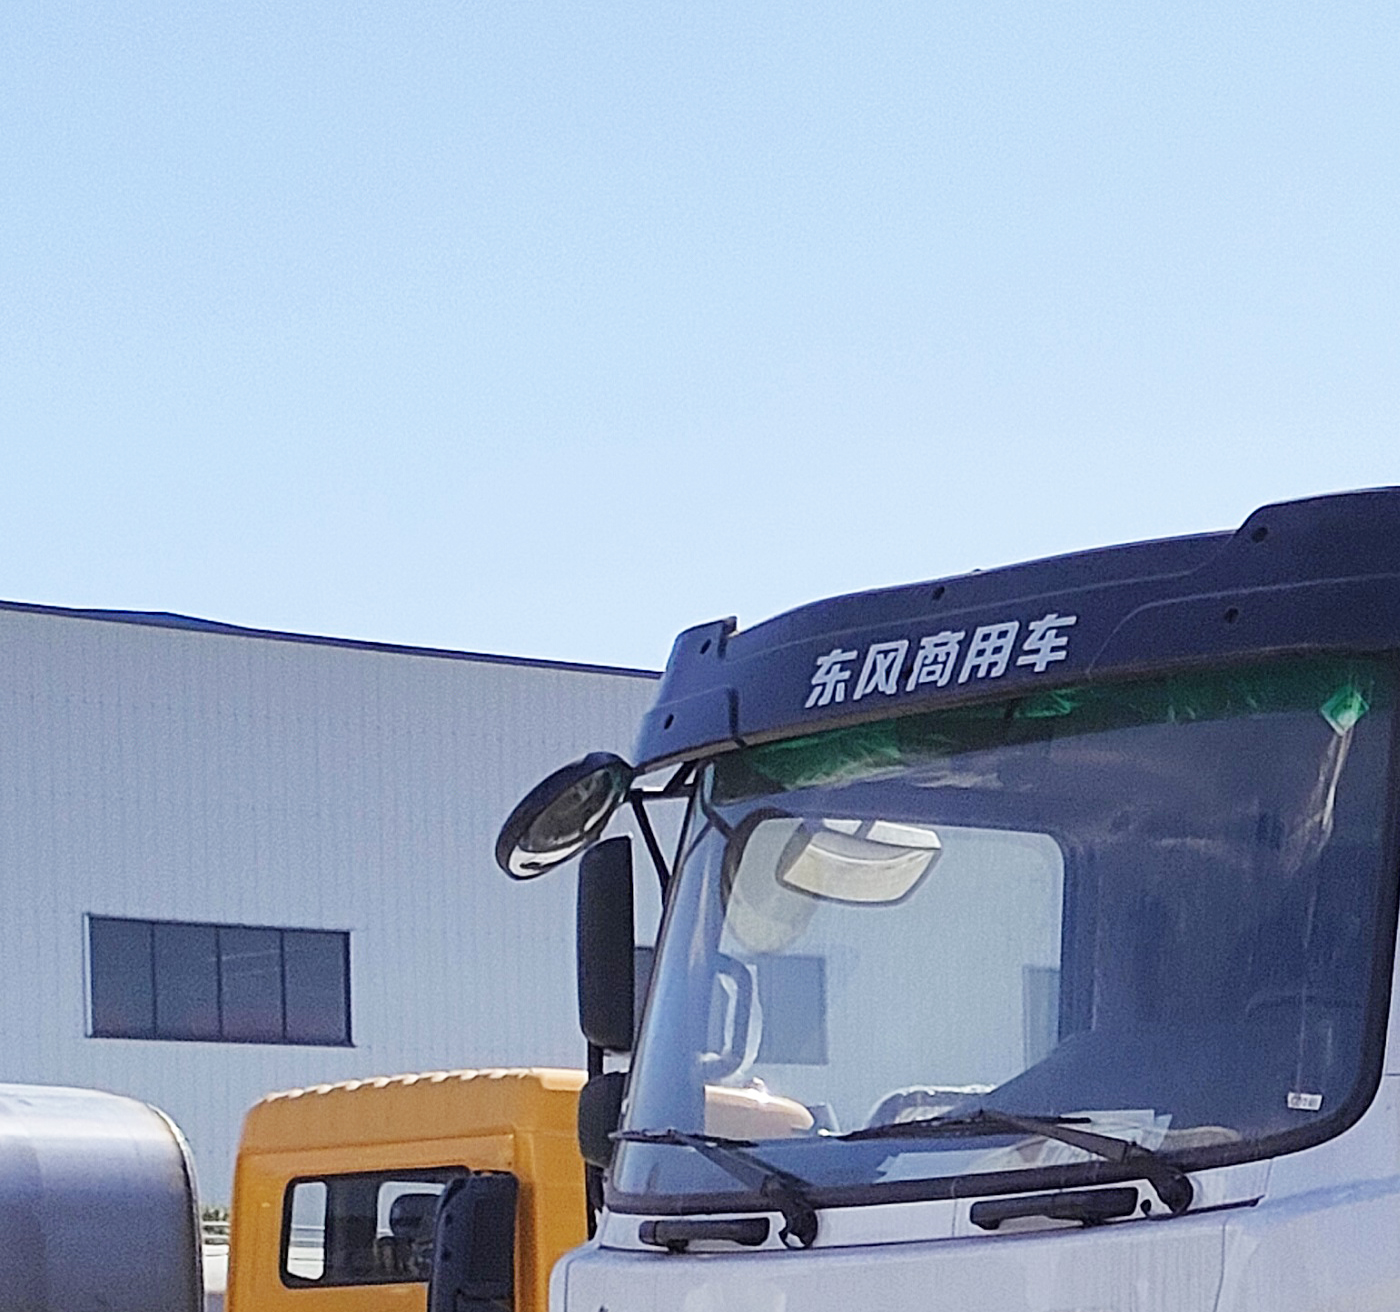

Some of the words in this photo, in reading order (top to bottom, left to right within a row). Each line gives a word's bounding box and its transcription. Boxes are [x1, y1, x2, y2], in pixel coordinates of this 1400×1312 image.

[804, 613, 1077, 708] 东风商用车
